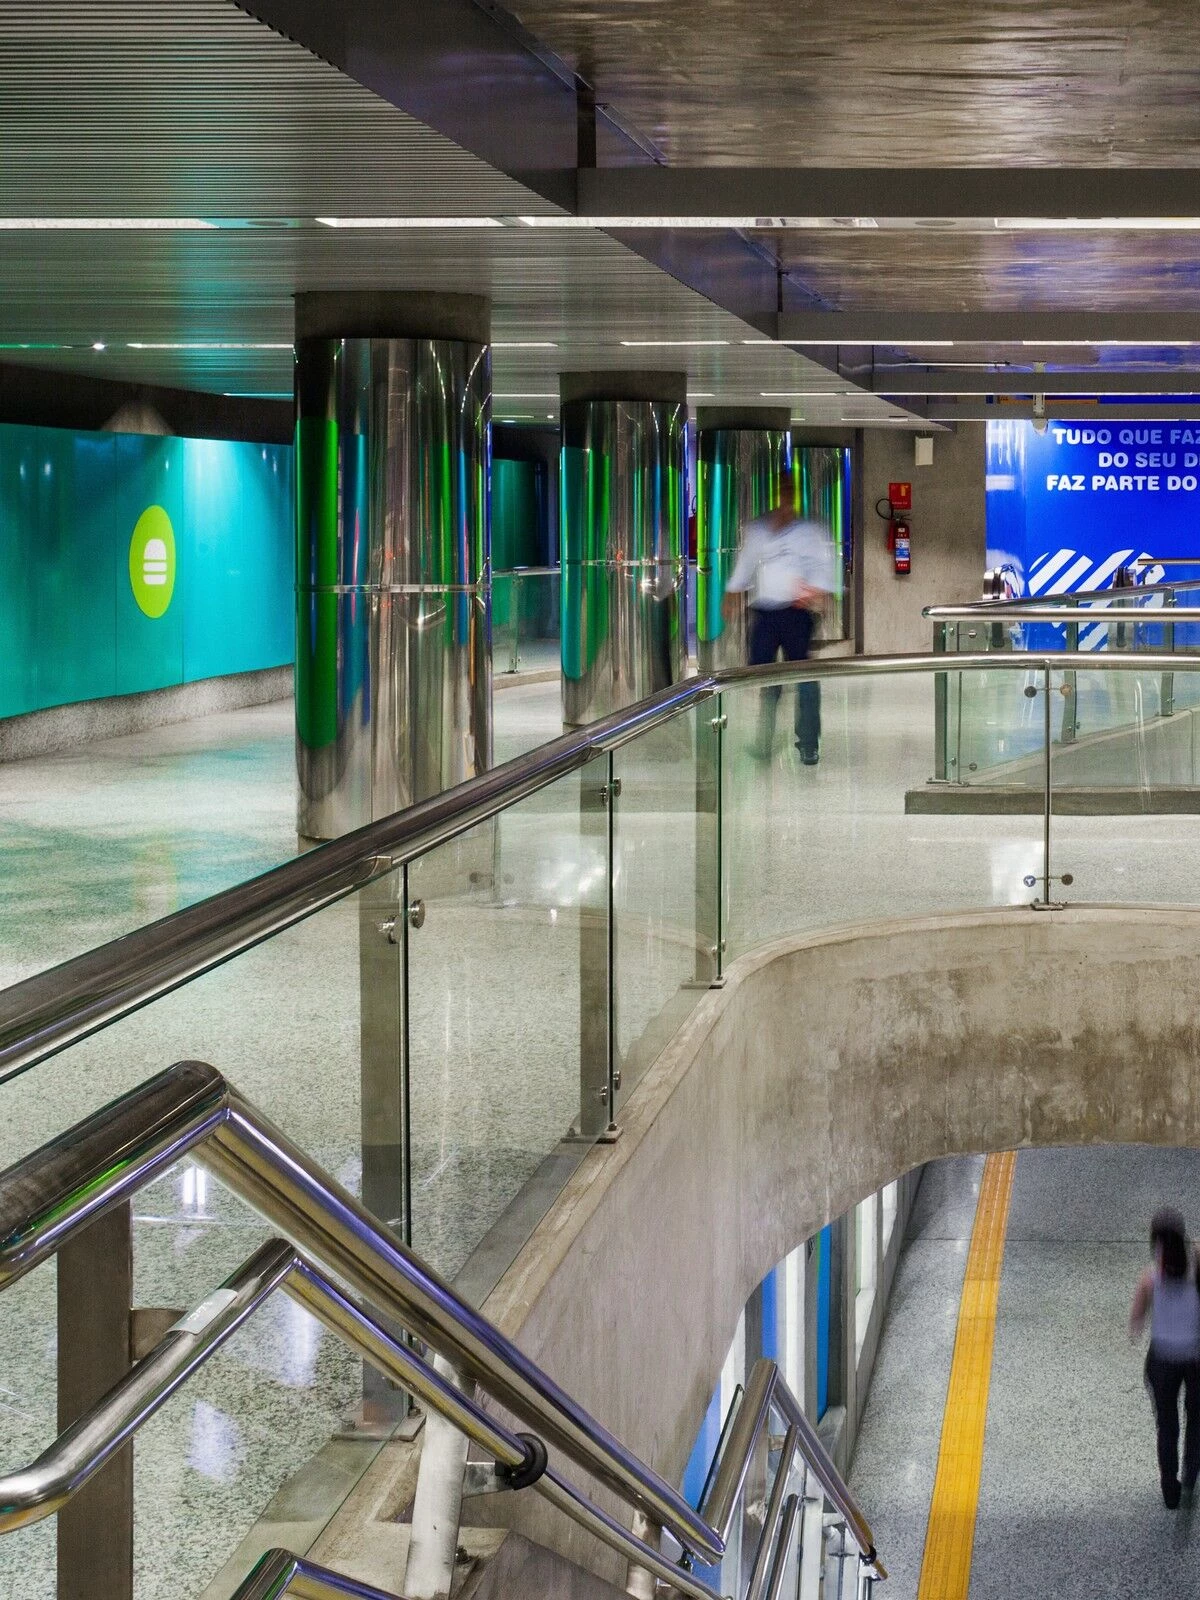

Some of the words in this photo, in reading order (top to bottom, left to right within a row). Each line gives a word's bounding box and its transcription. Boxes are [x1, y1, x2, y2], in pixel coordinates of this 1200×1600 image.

[1052, 428, 1112, 444] TUDO
[1119, 429, 1163, 445] QUE
[1098, 453, 1129, 468] DO
[1135, 452, 1176, 468] SEU
[1046, 475, 1085, 491] FAZ
[1092, 475, 1160, 491] PARTE
[1167, 475, 1198, 491] DO
